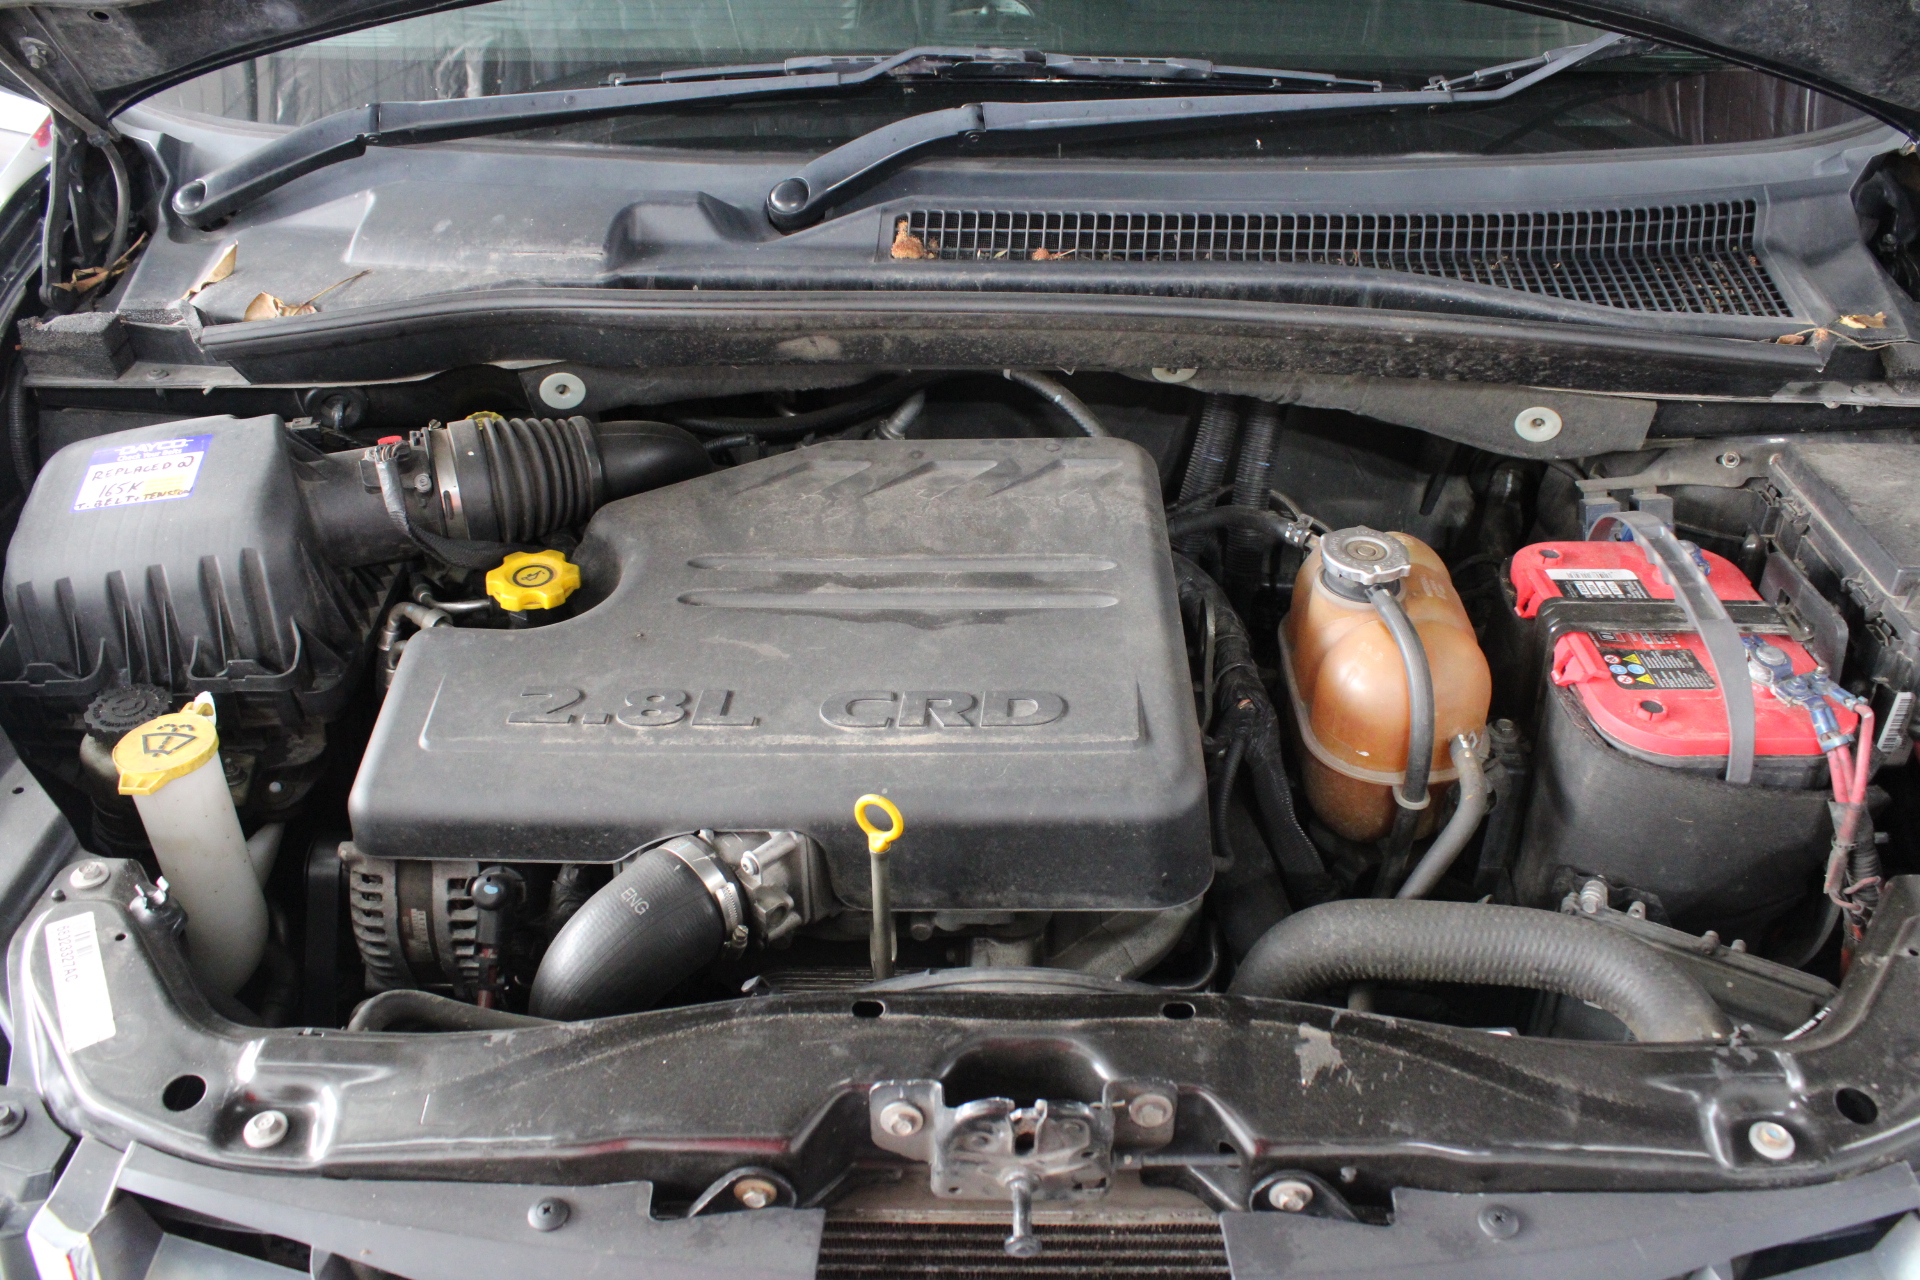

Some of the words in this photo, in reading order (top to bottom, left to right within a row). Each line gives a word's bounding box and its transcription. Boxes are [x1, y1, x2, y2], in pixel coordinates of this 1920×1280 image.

[115, 438, 191, 455] DAYCO
[117, 453, 141, 462] Check
[143, 450, 161, 459] Your
[92, 462, 172, 481] REPLACED
[98, 480, 144, 498] 165K
[506, 686, 761, 727] 2.8L
[819, 689, 1069, 729] CRD
[620, 887, 650, 916] ENG
